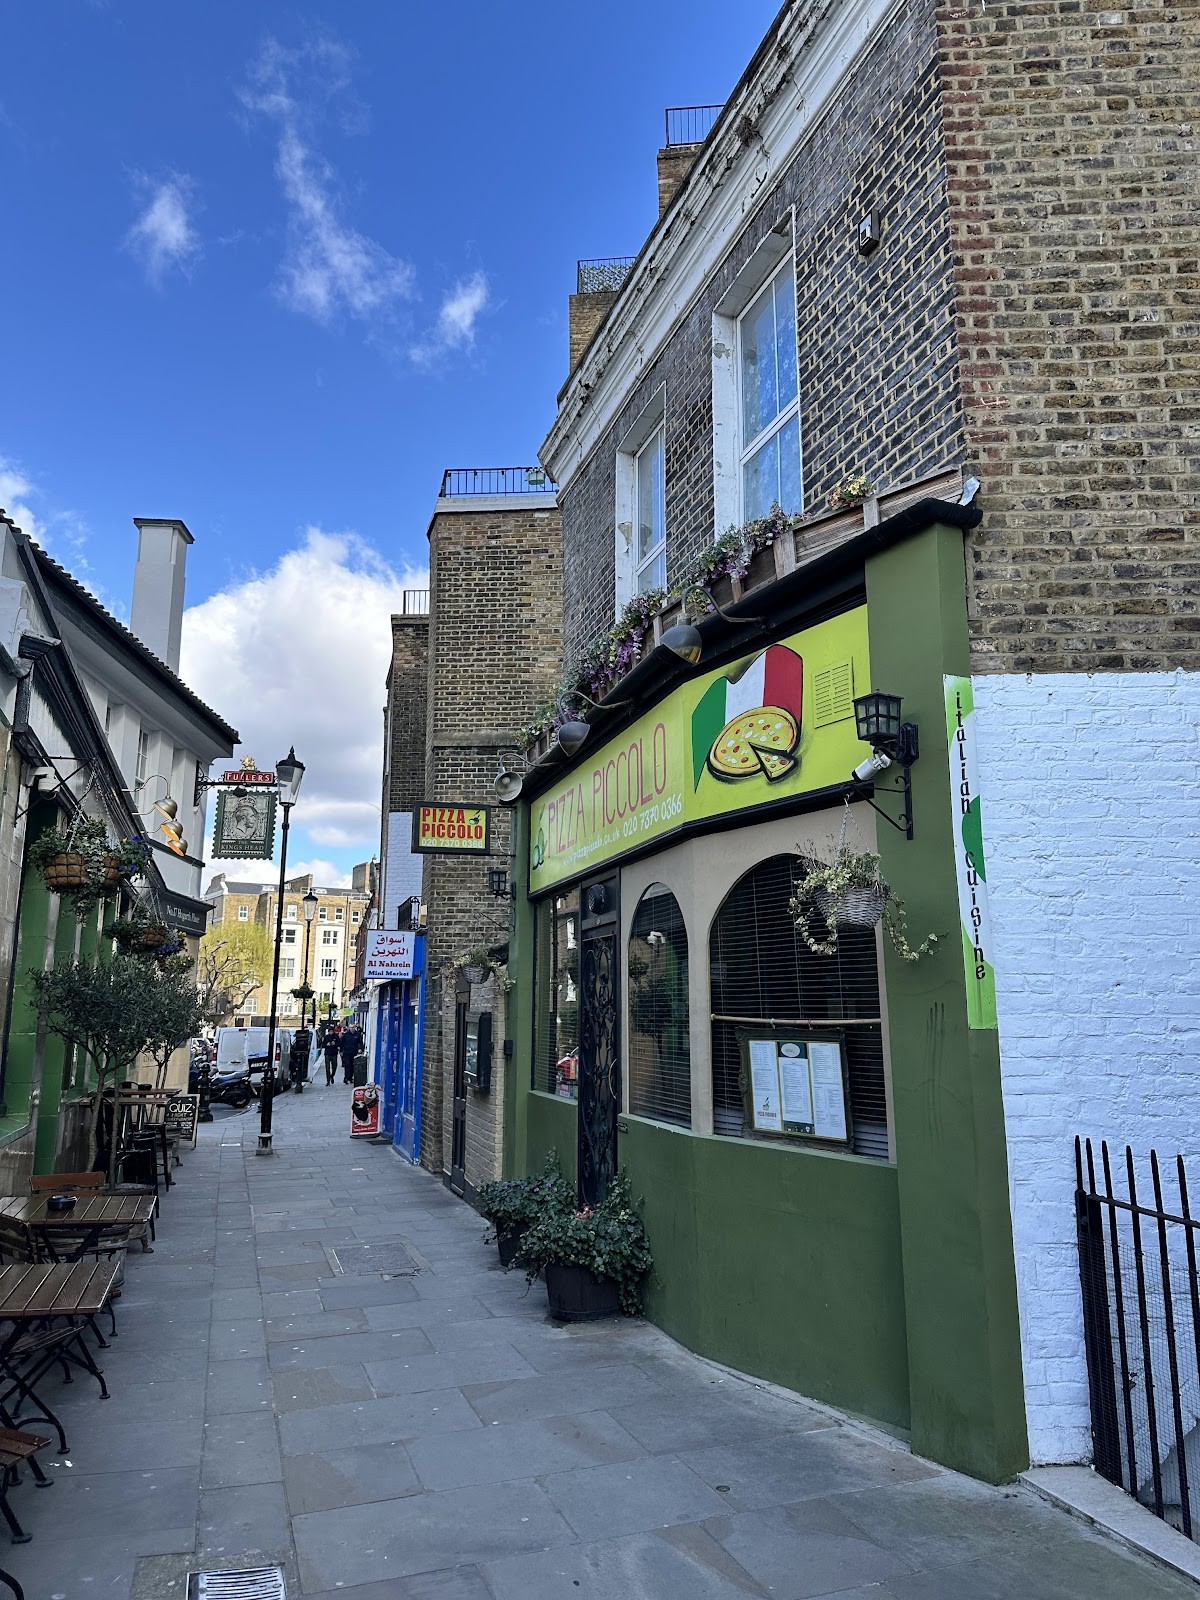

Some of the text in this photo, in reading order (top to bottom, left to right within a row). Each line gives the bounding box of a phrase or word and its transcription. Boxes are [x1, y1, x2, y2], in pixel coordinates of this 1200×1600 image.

[955, 691, 972, 815] italian
[547, 722, 667, 858] PIZZA PICCOLO
[422, 808, 465, 823] PIZZA
[623, 817, 638, 837] 020
[639, 806, 659, 831] 7370
[661, 793, 682, 821] 0366
[422, 823, 483, 839] PICCOLO
[440, 839, 460, 847] 7370
[462, 840, 483, 848] 0366
[965, 851, 986, 980] cuisine
[376, 934, 405, 945] أسواق
[372, 946, 409, 957] النهرين
[379, 960, 411, 968] Nahrein
[169, 1103, 193, 1113] QUIZ
